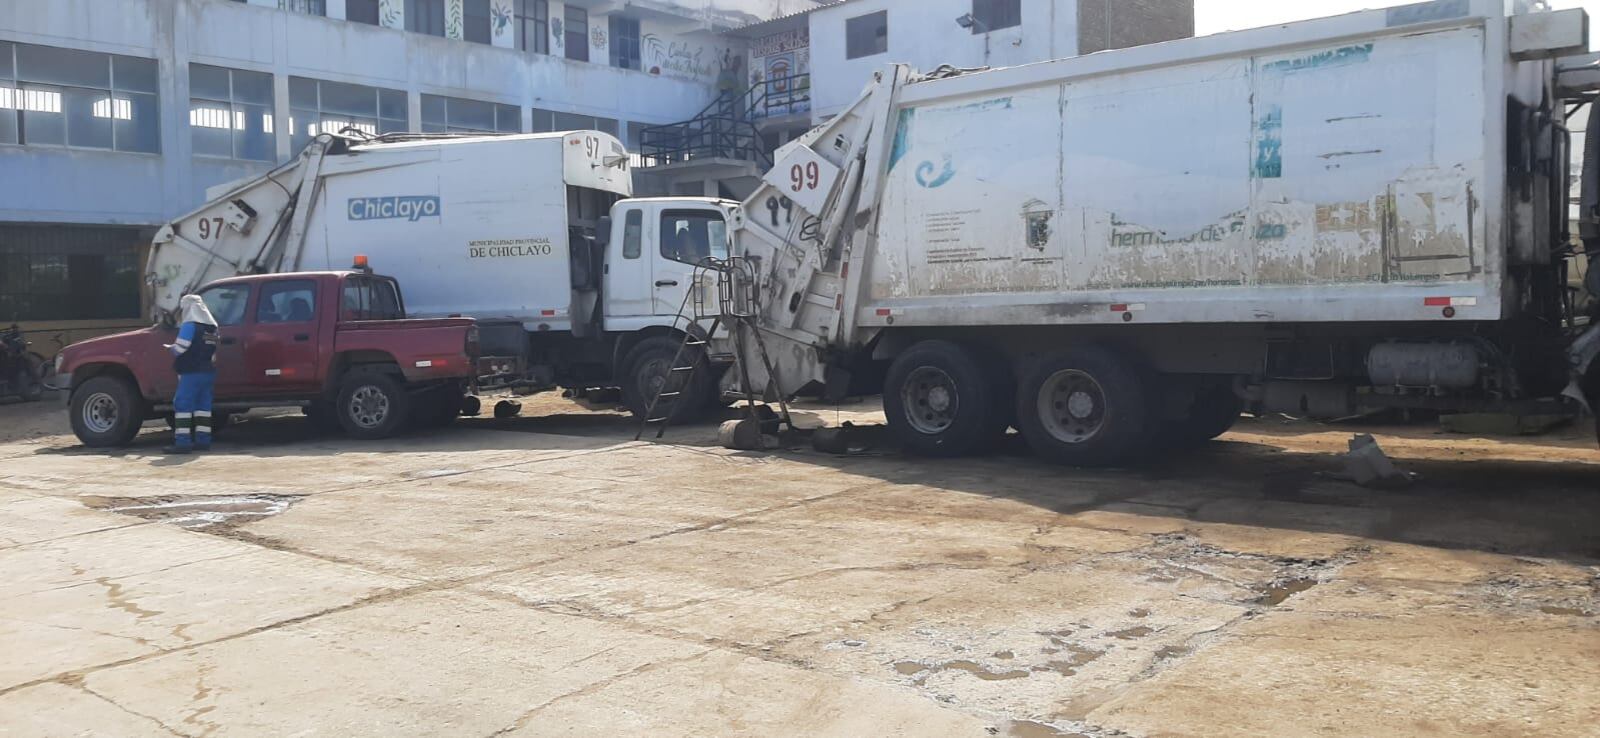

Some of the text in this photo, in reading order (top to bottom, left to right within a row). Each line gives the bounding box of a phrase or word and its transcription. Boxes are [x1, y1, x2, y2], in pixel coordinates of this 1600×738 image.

[586, 135, 599, 160] 97
[790, 161, 819, 192] 99
[350, 198, 437, 220] Chiclayo
[766, 195, 793, 227] 99
[198, 217, 224, 240] 97
[469, 237, 550, 247] MUNICIPALIDAD PROVINCIAL
[470, 245, 551, 258] DE CHICLAYO
